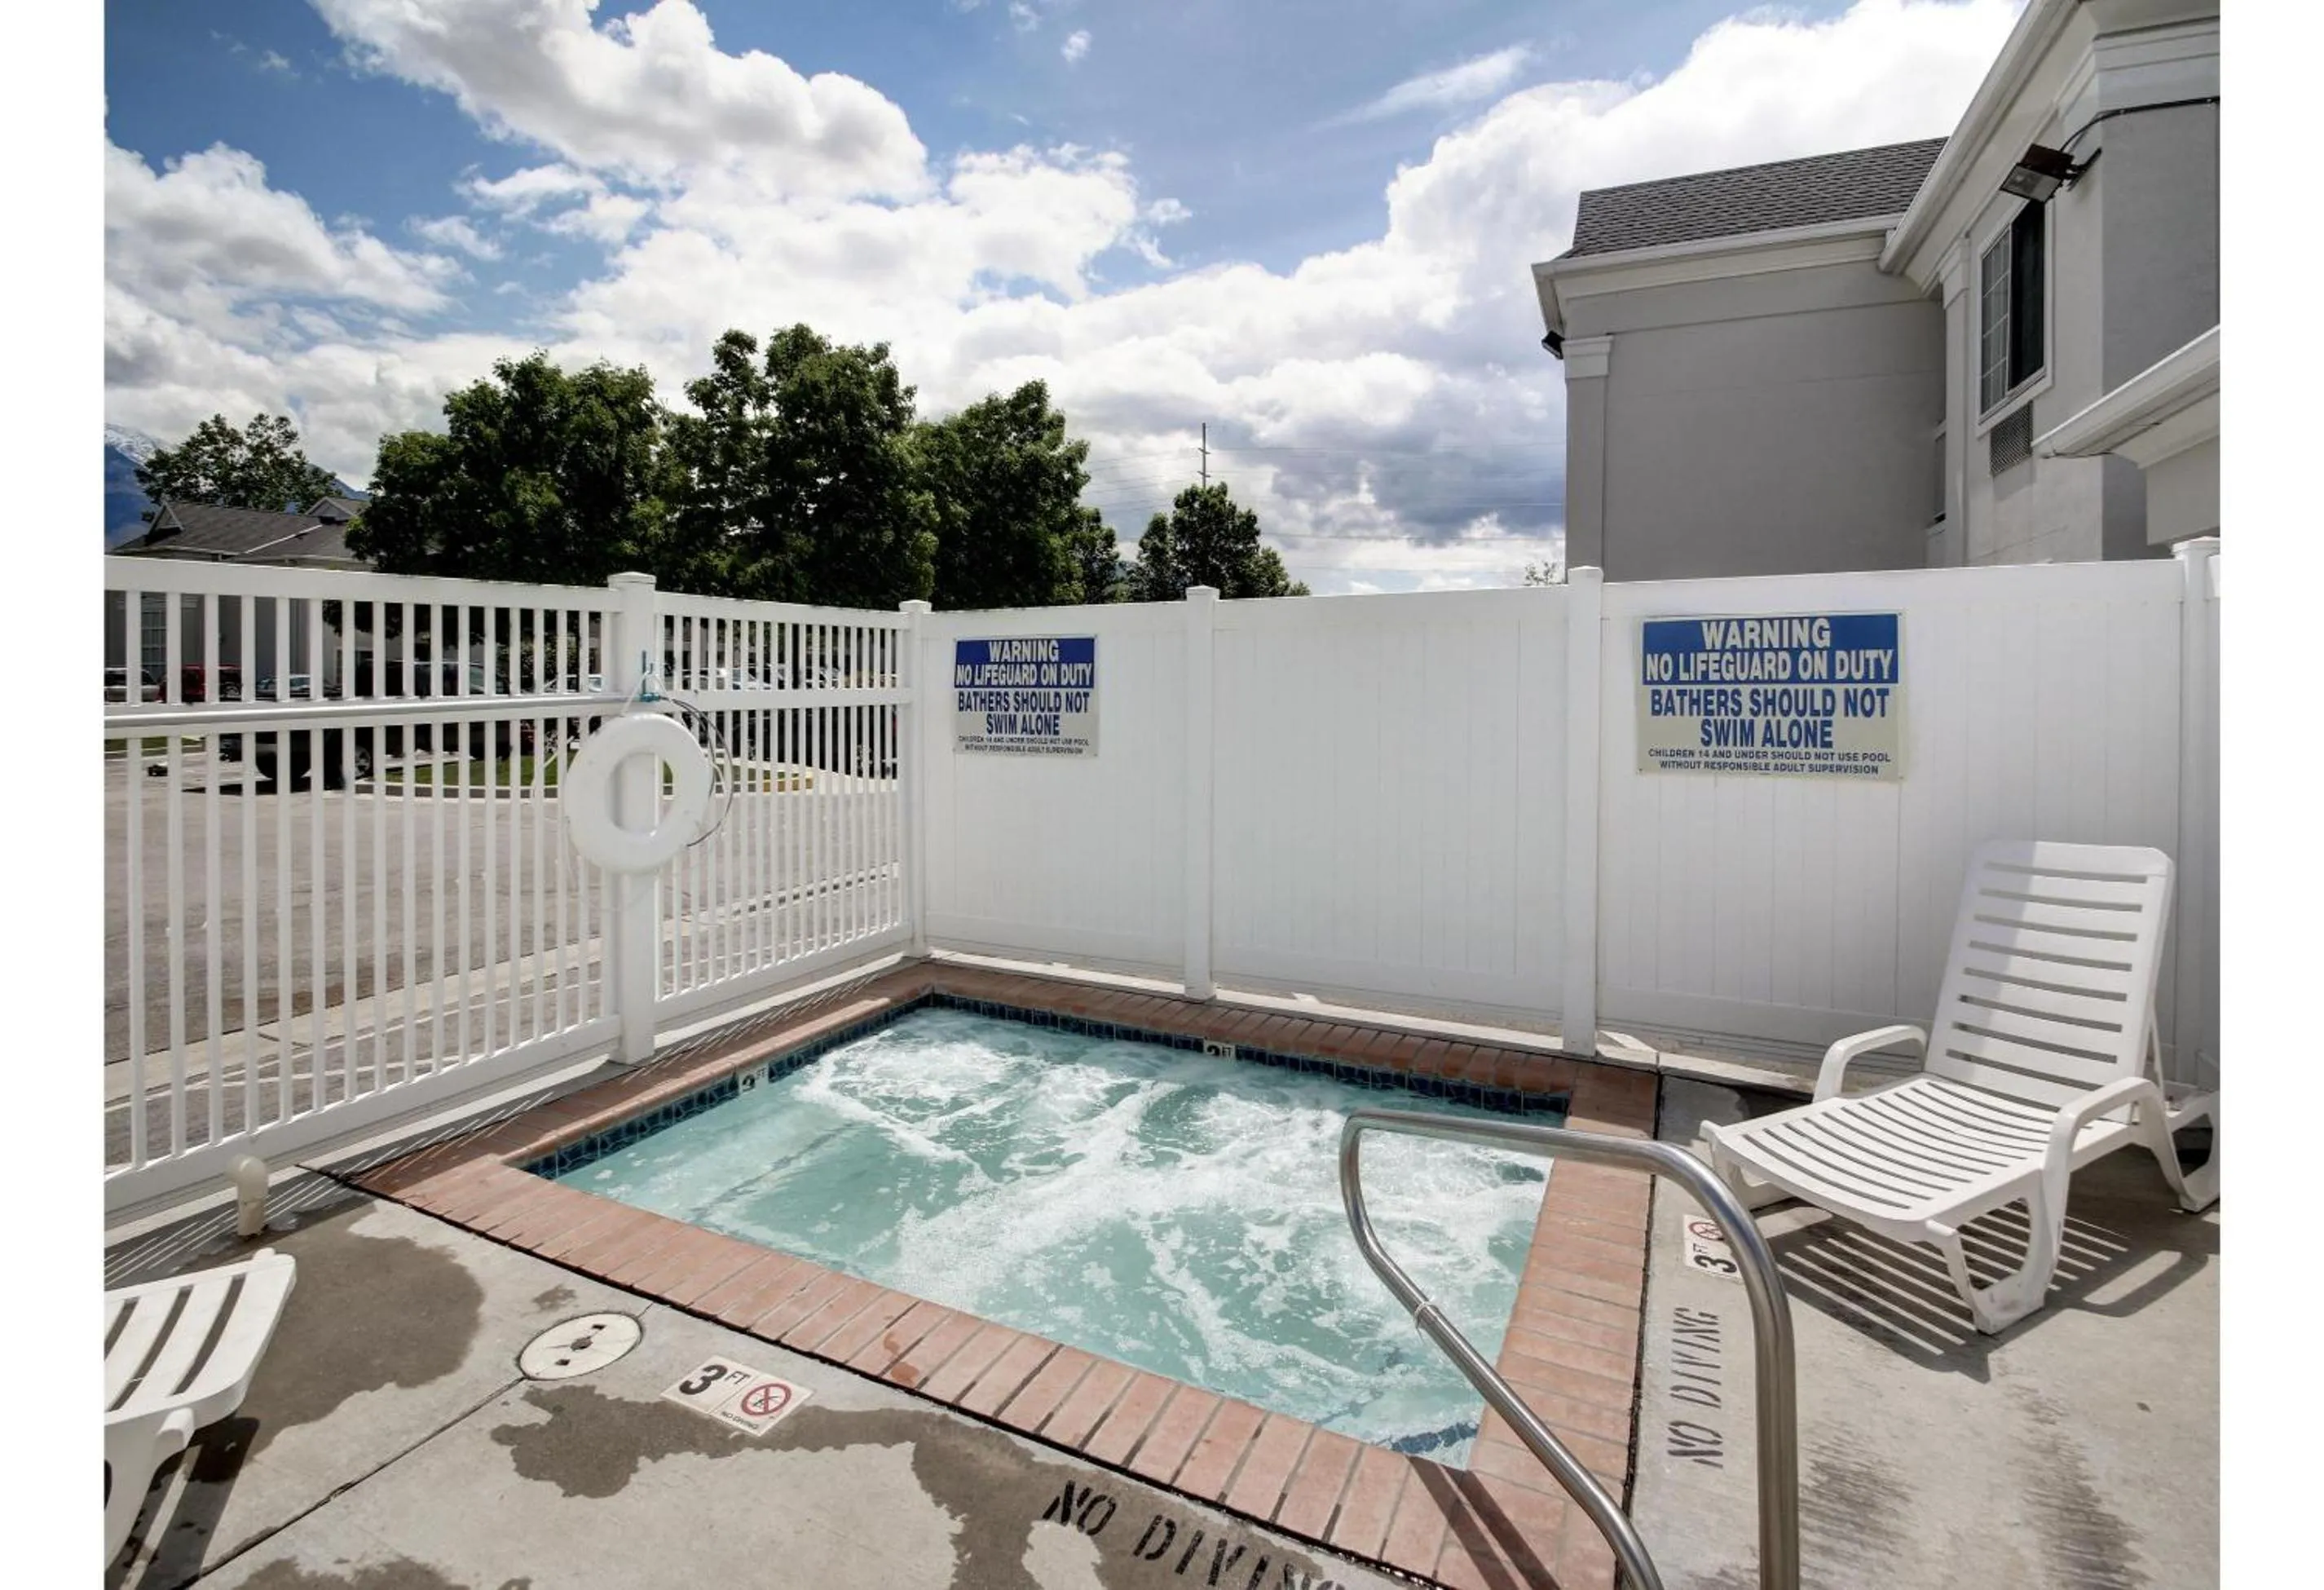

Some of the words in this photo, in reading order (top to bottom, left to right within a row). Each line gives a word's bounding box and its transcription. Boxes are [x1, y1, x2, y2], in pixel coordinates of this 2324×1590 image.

[1701, 618, 1831, 650] WARNING
[989, 640, 1059, 662] WARNING
[955, 665, 972, 686] NO
[974, 664, 1038, 686] LIFEGUARD
[1040, 664, 1058, 685] ON
[1061, 663, 1092, 686] DUTY
[1646, 652, 1672, 682] NO
[1678, 651, 1792, 682] LIFEGUARD
[1798, 650, 1828, 680] ON
[1835, 649, 1894, 680] DUTY
[959, 691, 1010, 712] BATHERS
[1013, 691, 1061, 713] SHOULD
[1065, 692, 1090, 713] NOT
[1651, 688, 1743, 717] BATHERS
[1749, 688, 1836, 718] SHOULD
[1844, 688, 1890, 718] NOT
[986, 713, 1017, 735] SWIM
[1020, 714, 1060, 735] ALONE
[1700, 719, 1755, 748] SWIM
[1762, 719, 1833, 749] ALONE
[1648, 749, 1695, 757] CHILDREN
[1699, 749, 1709, 757] 14
[1712, 749, 1732, 758] AND
[1735, 750, 1768, 759] UNDER
[1771, 751, 1812, 760] SHOULD
[1814, 752, 1835, 761] NOT
[1838, 753, 1859, 762] USE
[1862, 753, 1891, 762] POOL
[1660, 760, 1702, 770] WITHOUT
[1704, 761, 1771, 771] RESPONSIBLE
[1773, 763, 1806, 772] ADULT
[1808, 763, 1879, 774] SUPERVISION
[1693, 1243, 1709, 1254] FT
[1693, 1255, 1738, 1273] 3
[1669, 1307, 1722, 1409] DIVING
[678, 1364, 729, 1396] 3
[724, 1371, 753, 1385] FT
[1668, 1420, 1723, 1468] NO
[1042, 1479, 1117, 1535] NO
